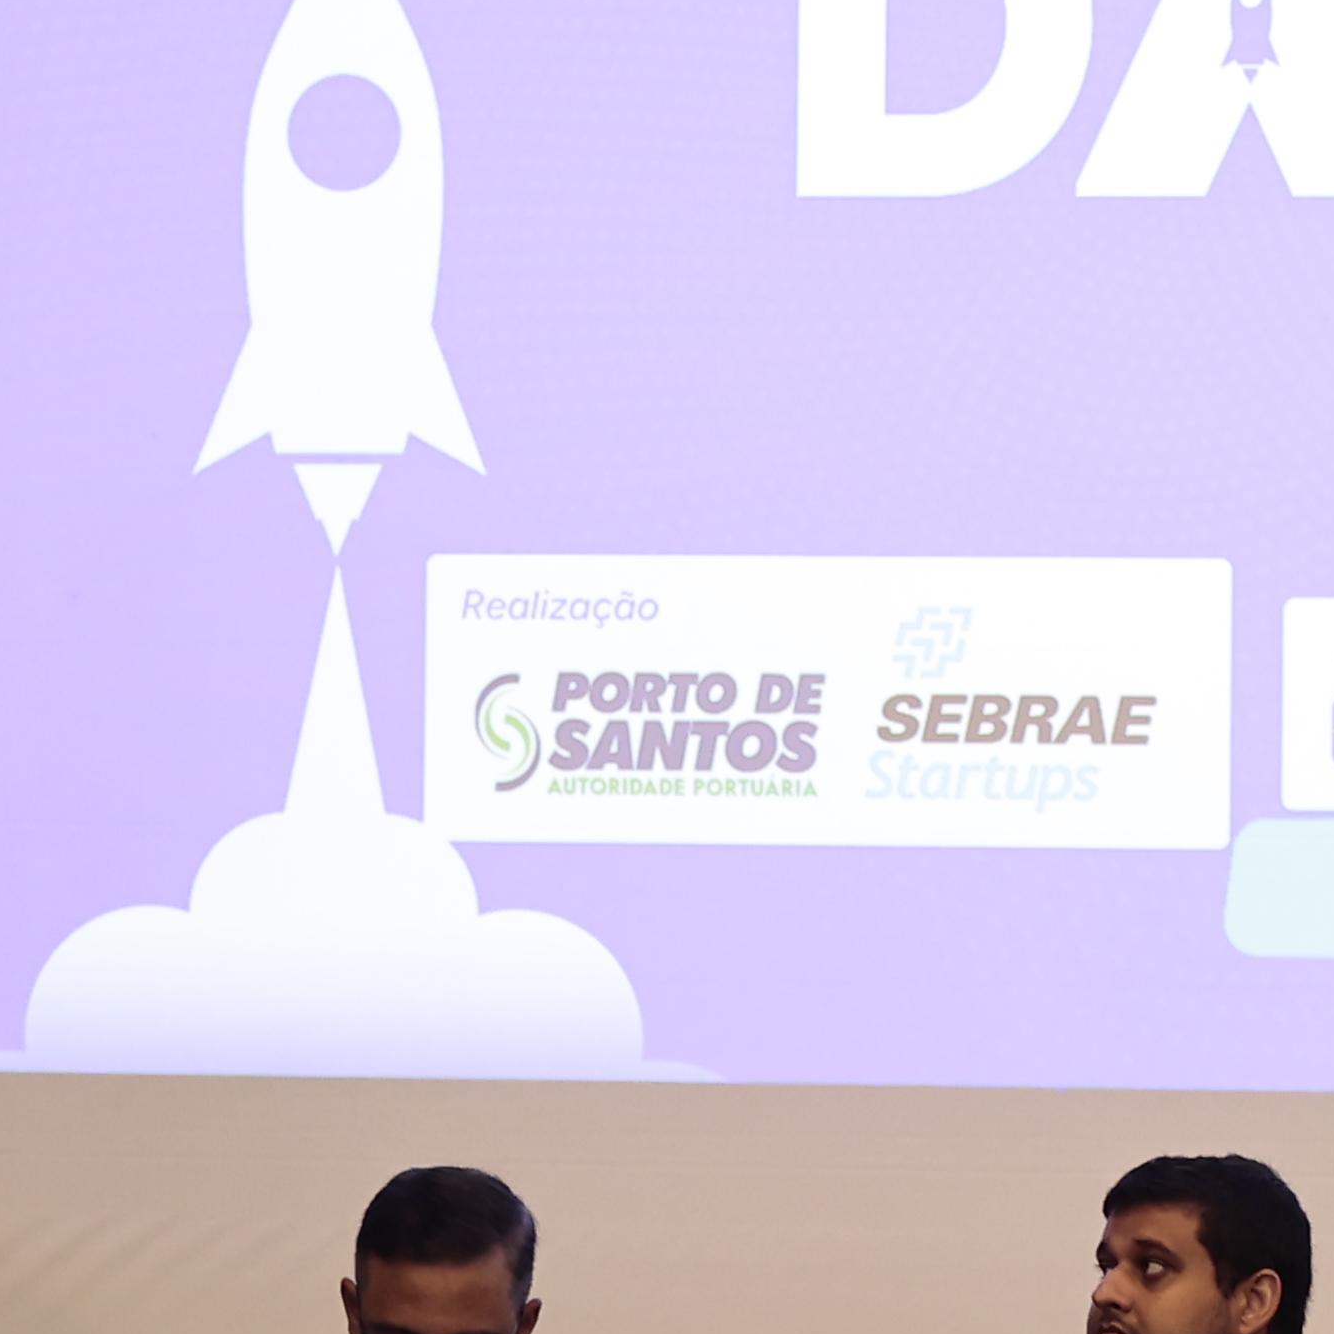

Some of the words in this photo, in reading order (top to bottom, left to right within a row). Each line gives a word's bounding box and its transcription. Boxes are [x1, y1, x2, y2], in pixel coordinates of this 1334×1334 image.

[461, 589, 660, 627] Realização
[551, 671, 740, 714] PORTO
[754, 672, 826, 715] DE
[876, 693, 1157, 746] SEBRAE
[548, 718, 821, 774] SANTOS
[547, 776, 686, 798] AUTORIDADE
[693, 775, 819, 799] PORTUÁRIA
[865, 750, 1101, 814] Startups
